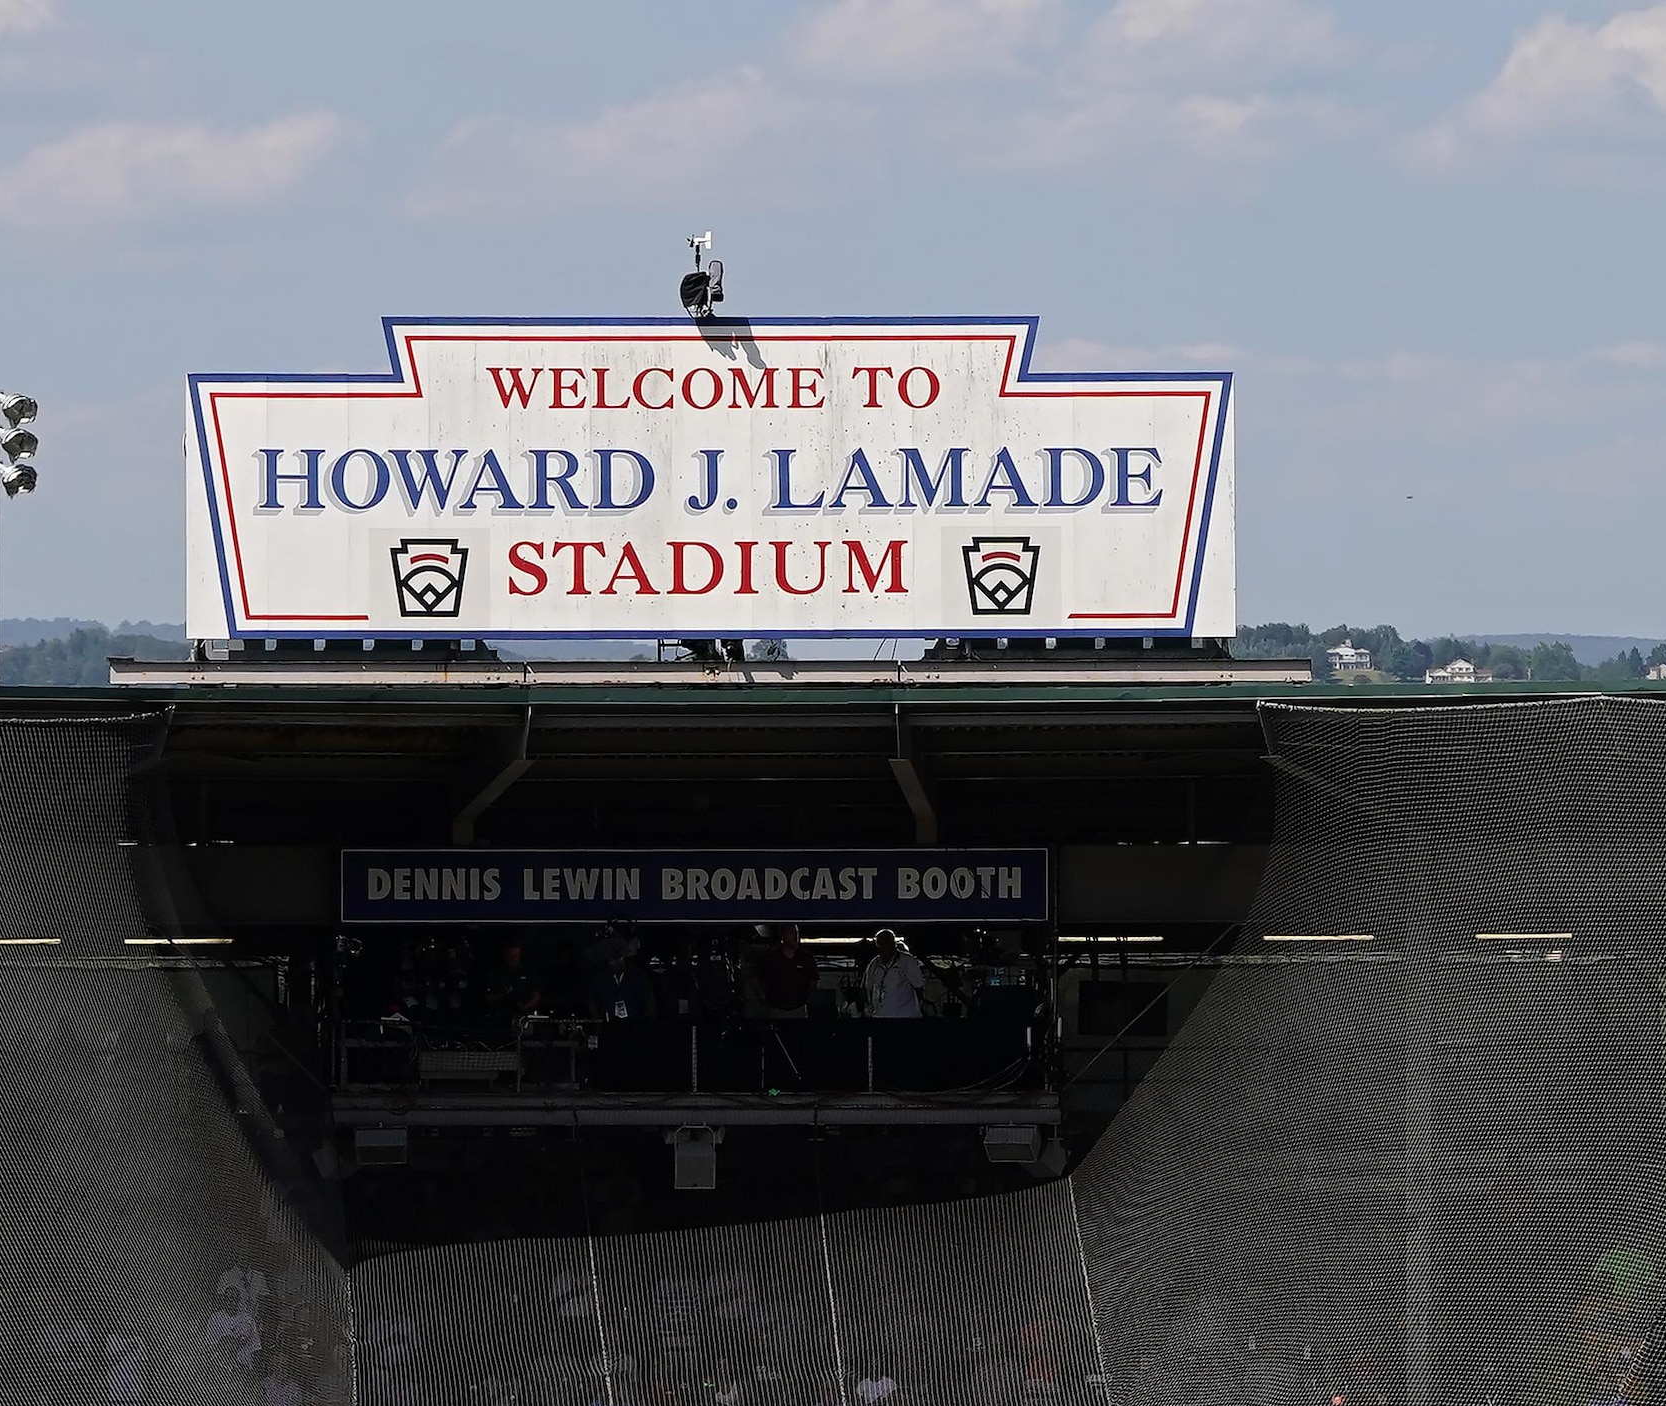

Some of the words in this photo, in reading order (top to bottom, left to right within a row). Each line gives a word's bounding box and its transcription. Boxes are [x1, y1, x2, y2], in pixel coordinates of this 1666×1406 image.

[489, 366, 825, 410] WELCOME
[852, 366, 940, 409] TO
[256, 447, 656, 511] HOWARD
[686, 448, 737, 511] J.
[771, 447, 1163, 511] LAMADE
[507, 539, 909, 597] STADIUM
[367, 868, 501, 901] DENNIS
[523, 868, 640, 900] LEWIN
[661, 867, 878, 901] BROADCAST
[897, 866, 1023, 900] BOOTH
